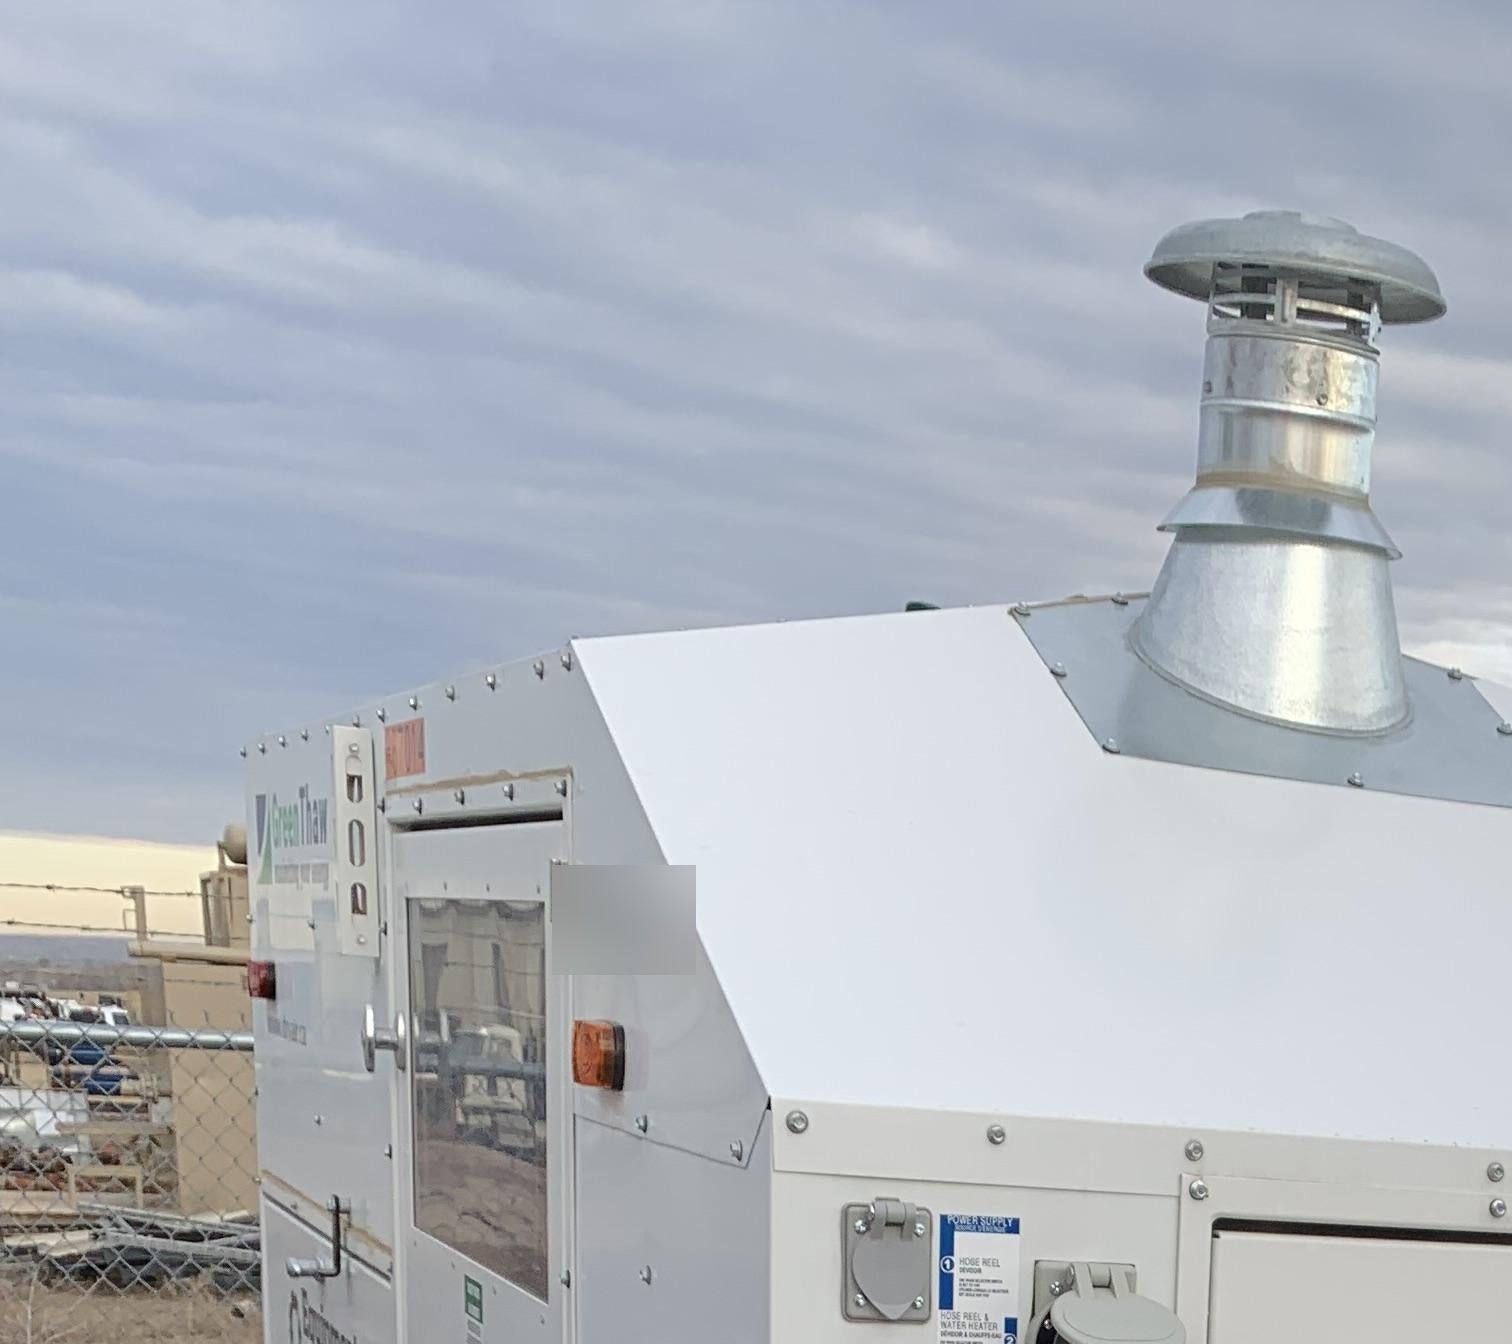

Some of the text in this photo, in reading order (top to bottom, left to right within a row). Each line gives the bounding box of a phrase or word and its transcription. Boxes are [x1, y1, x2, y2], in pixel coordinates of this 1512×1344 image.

[271, 783, 327, 849] GreenThaw
[947, 1214, 1013, 1227] POWER SUPPLY
[944, 1258, 951, 1270] 1
[959, 1257, 1000, 1268] HOSE REEL
[940, 1311, 960, 1320] HOSE
[963, 1312, 982, 1321] REEL
[940, 1321, 998, 1331] WATER HEATER
